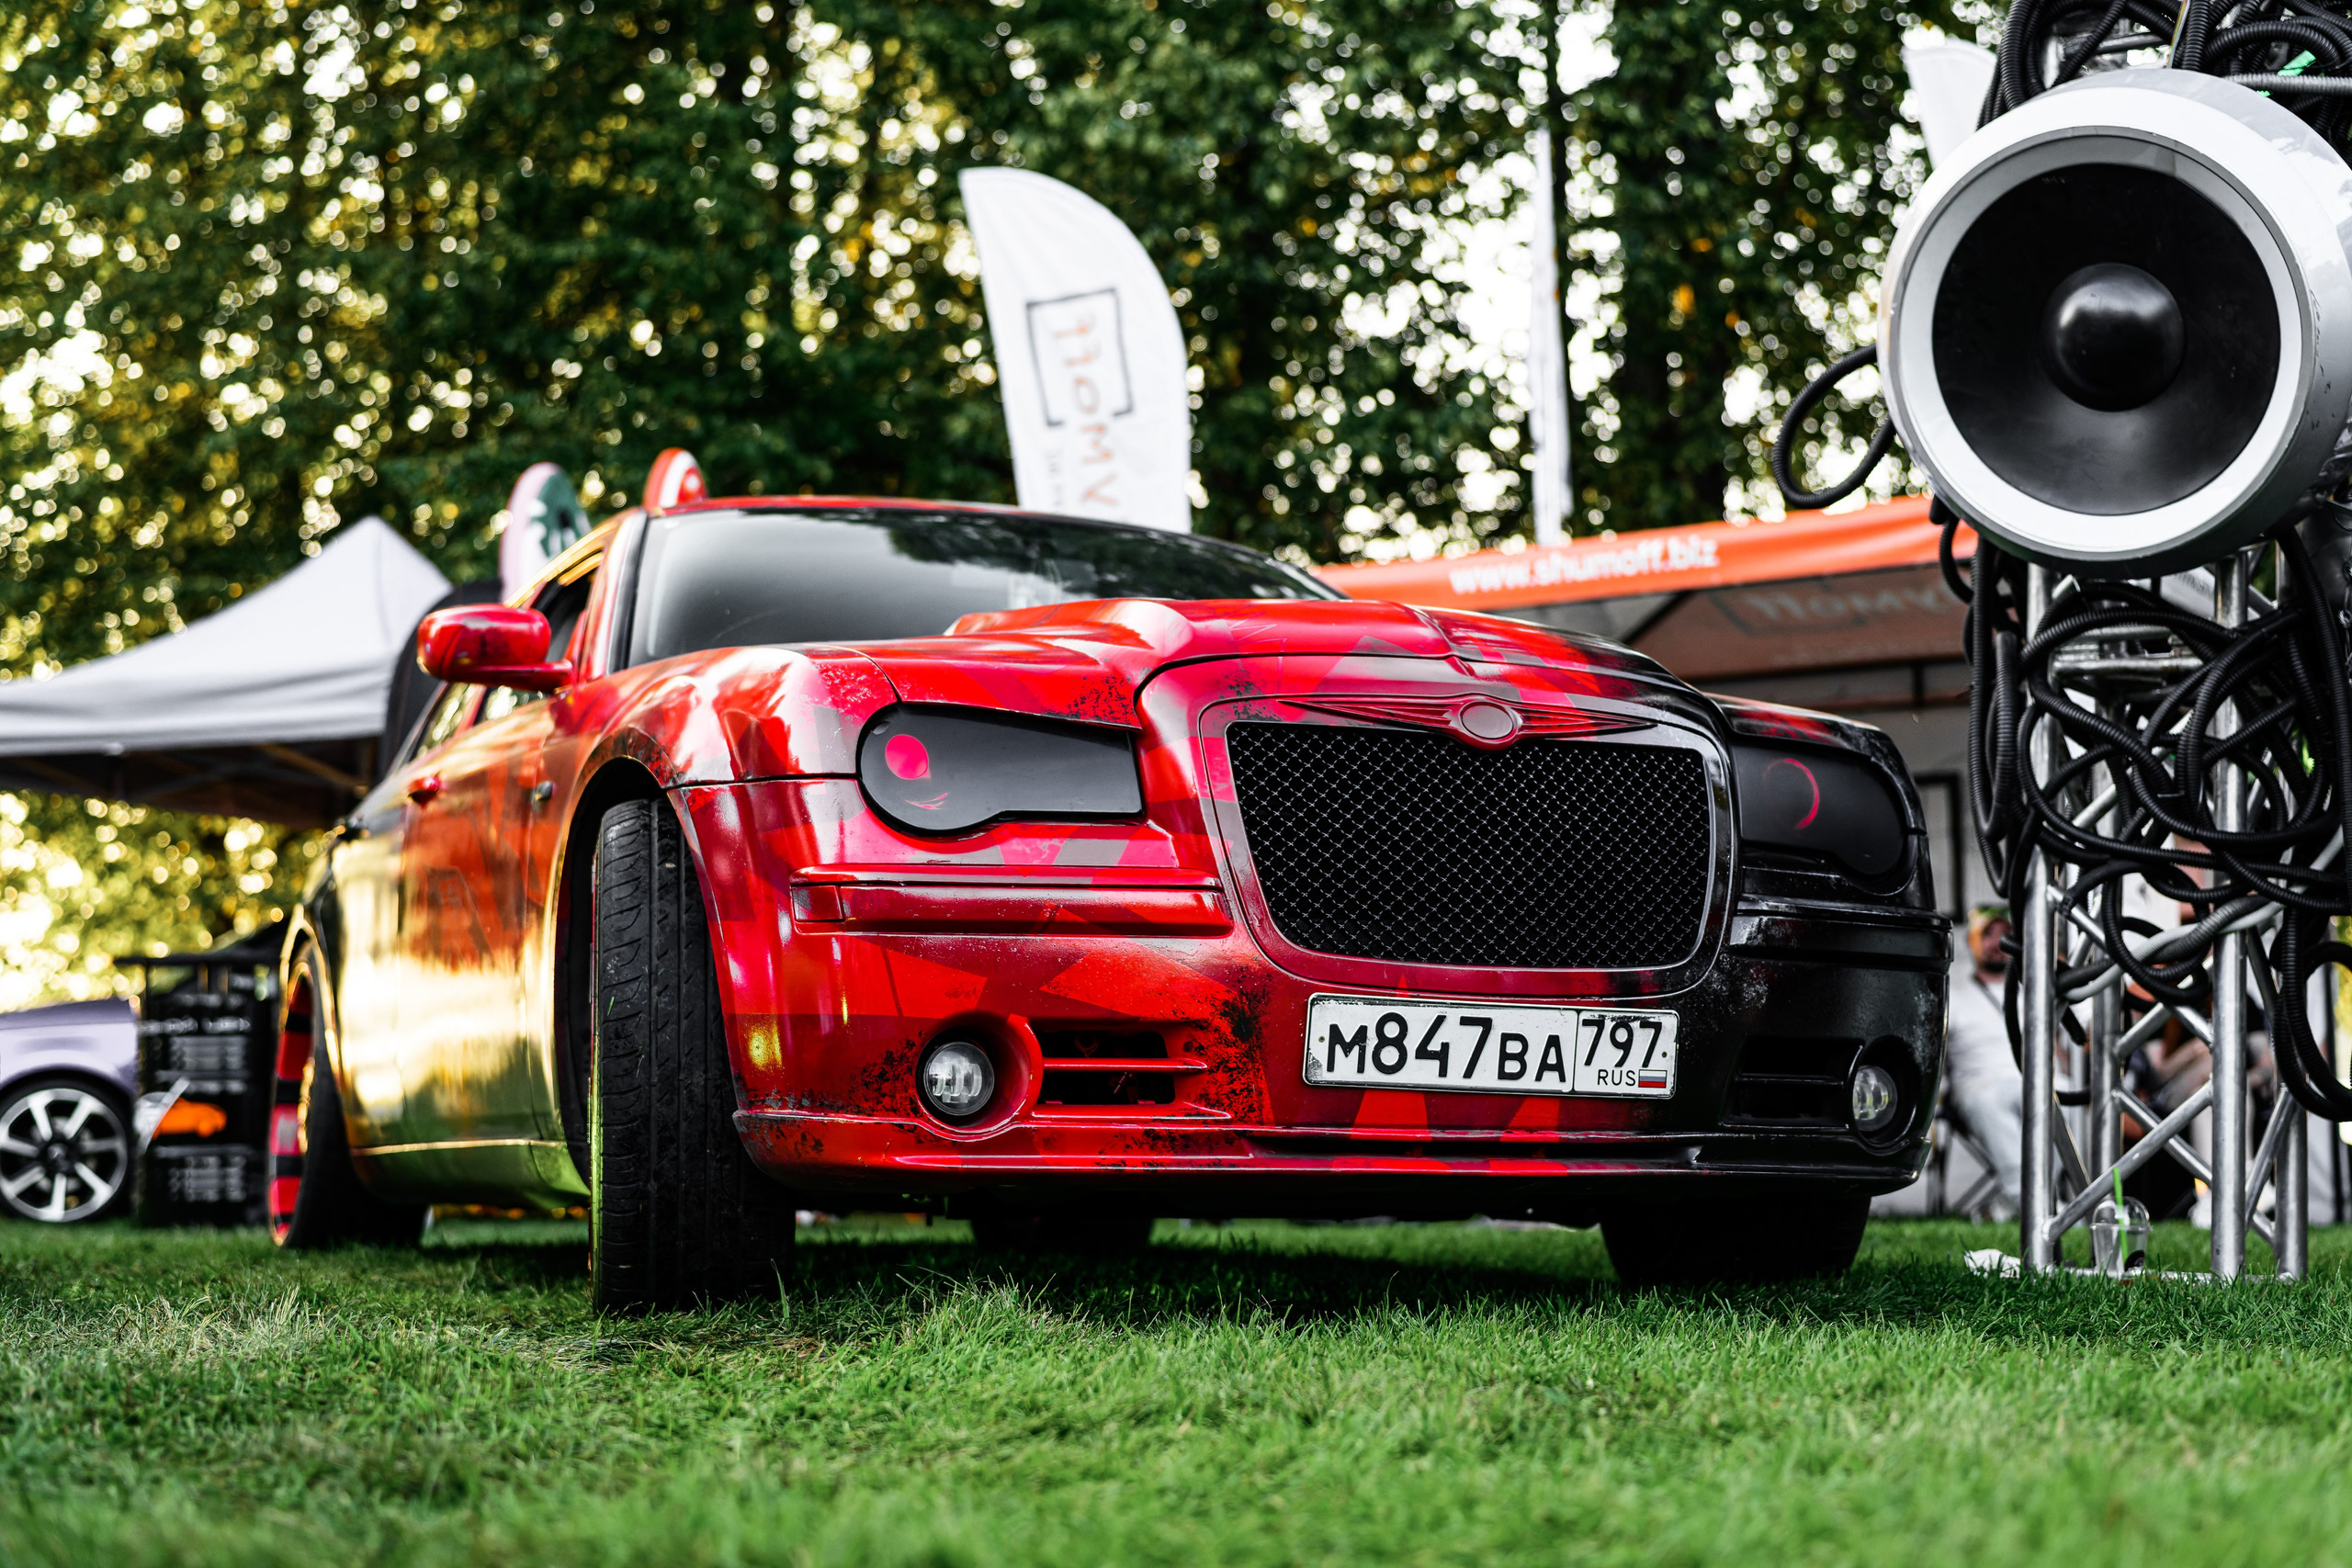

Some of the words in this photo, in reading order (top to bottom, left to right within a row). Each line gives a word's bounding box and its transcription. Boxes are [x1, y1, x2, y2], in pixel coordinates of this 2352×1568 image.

[1449, 535, 1719, 594] www.shumoff.biz
[1326, 1011, 1566, 1083] М847ВА
[1581, 1018, 1663, 1068] 797
[1597, 1068, 1636, 1087] RUS
